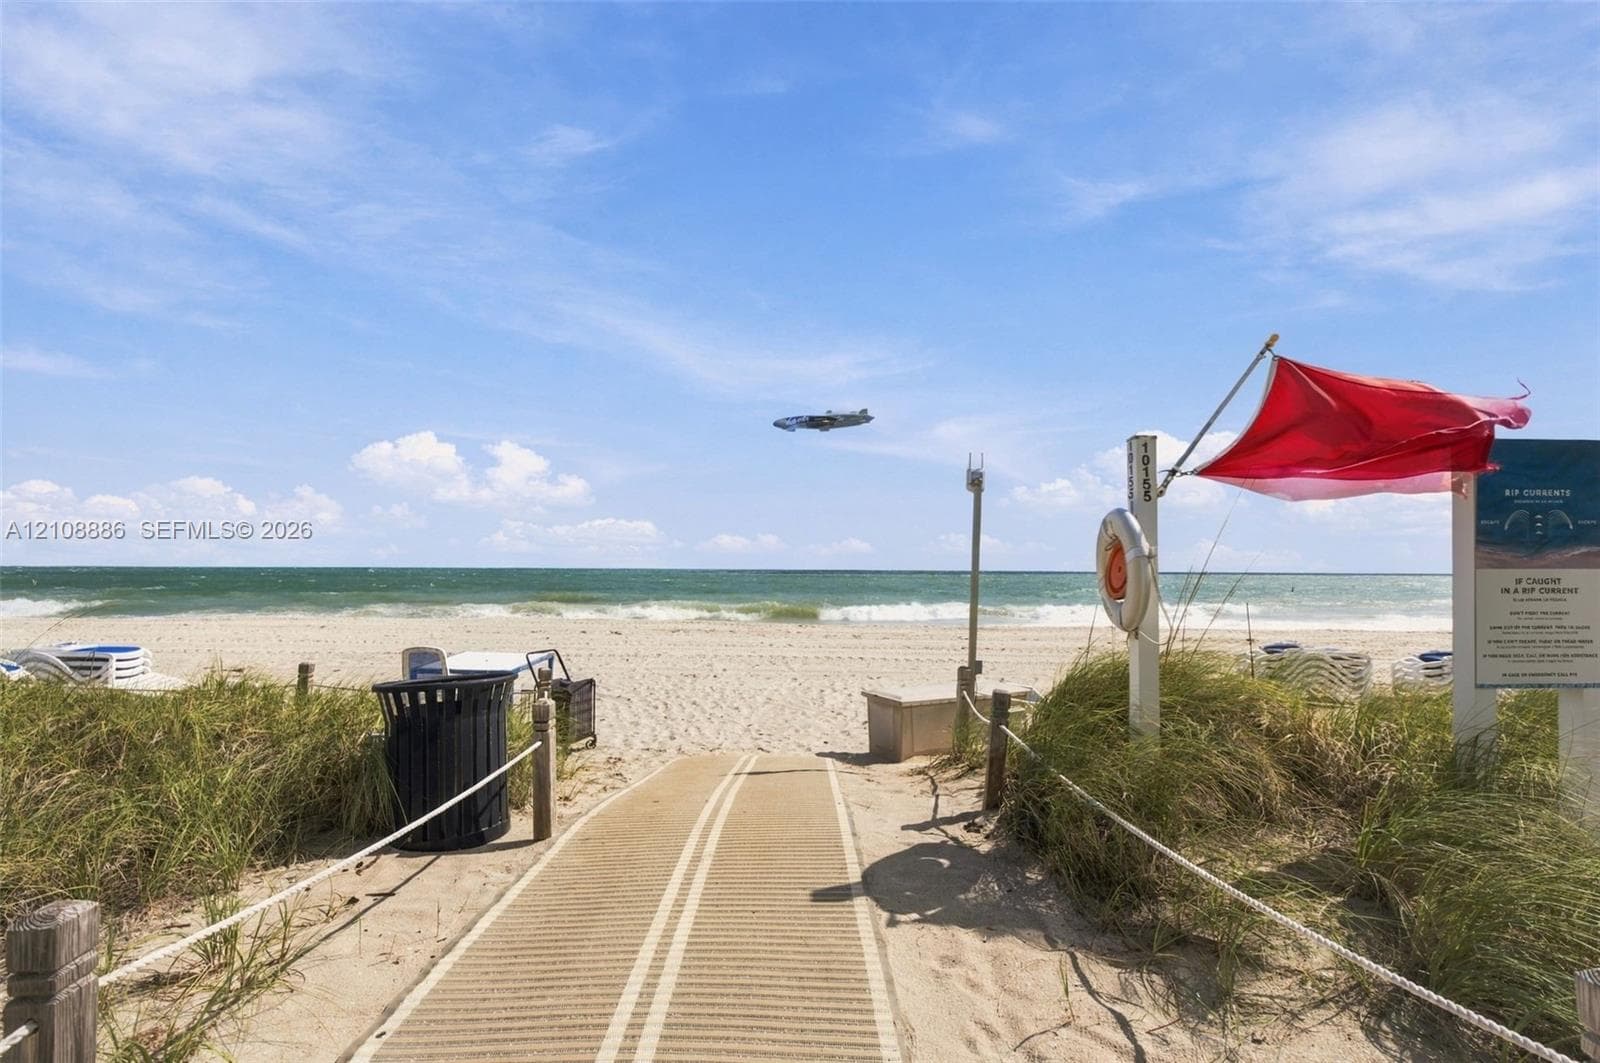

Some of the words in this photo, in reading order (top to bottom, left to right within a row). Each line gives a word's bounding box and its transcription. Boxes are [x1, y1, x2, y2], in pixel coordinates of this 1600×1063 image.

[1141, 441, 1152, 502] 10155
[1504, 489, 1520, 497] RIP
[1523, 489, 1571, 497] CURRENTS
